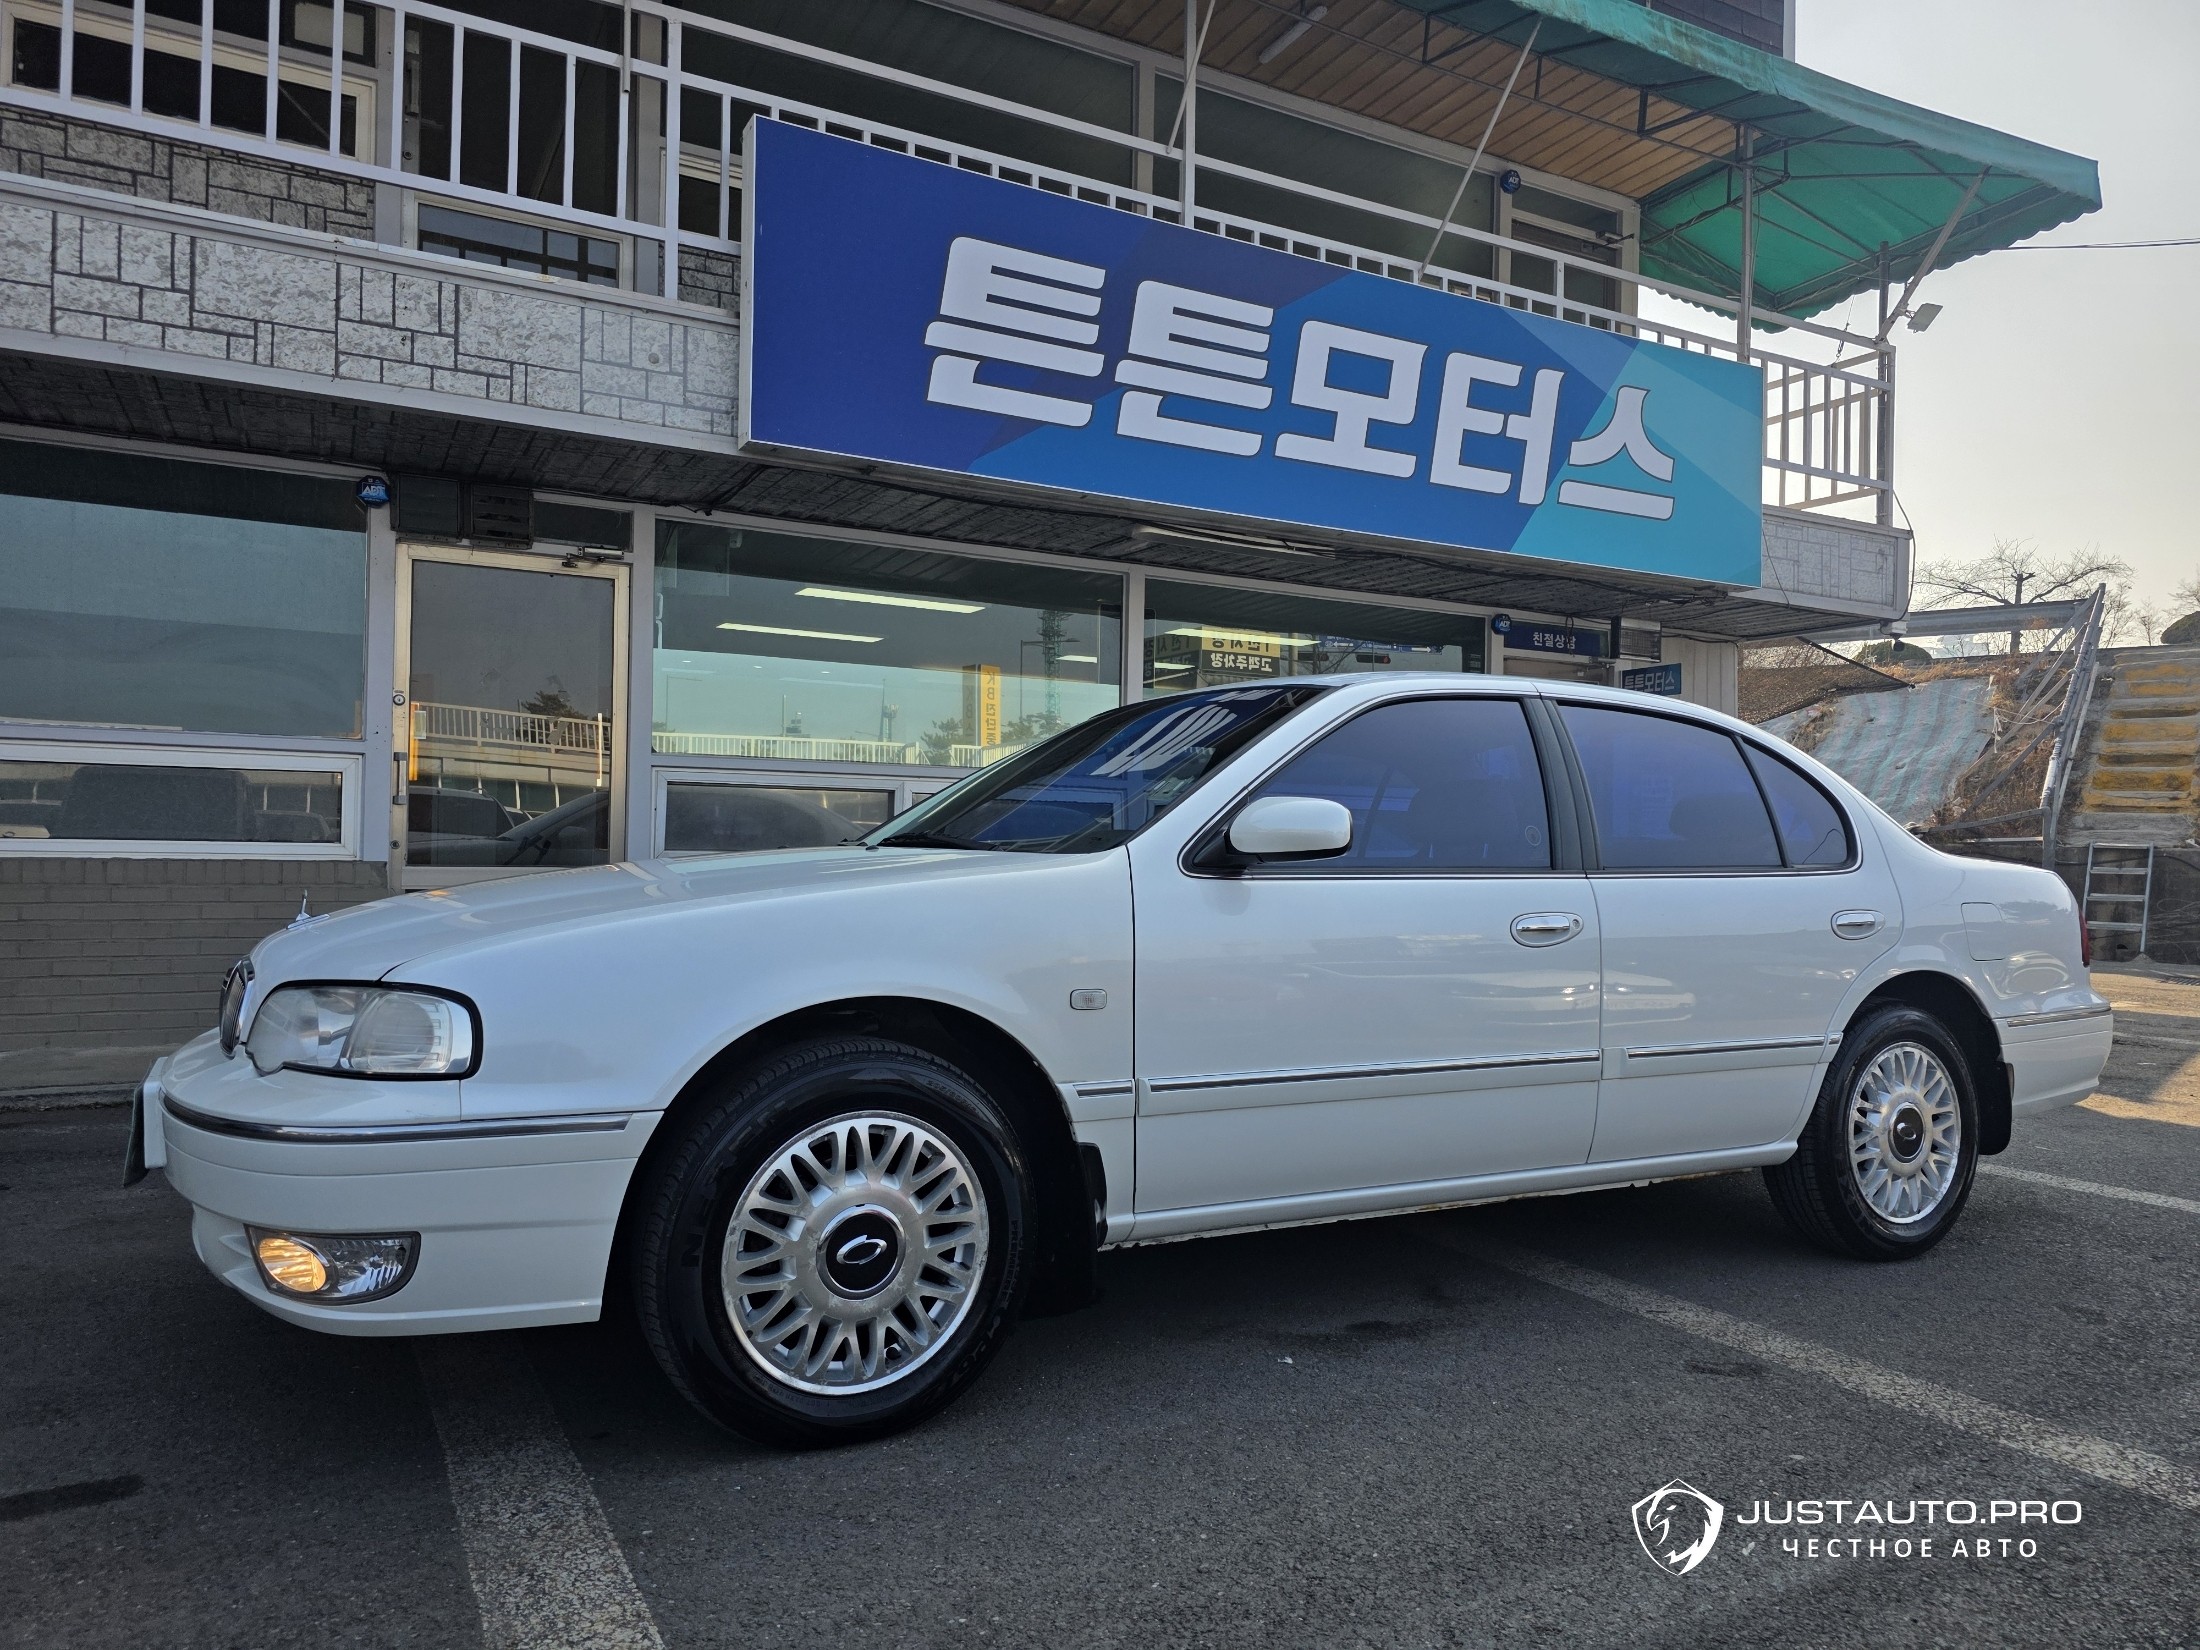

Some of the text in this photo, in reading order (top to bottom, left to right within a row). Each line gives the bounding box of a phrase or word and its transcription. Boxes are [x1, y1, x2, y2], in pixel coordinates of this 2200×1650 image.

[925, 235, 1676, 521] 튼튼모터스
[361, 485, 386, 496] ADT
[1532, 631, 1577, 650] 친절상담
